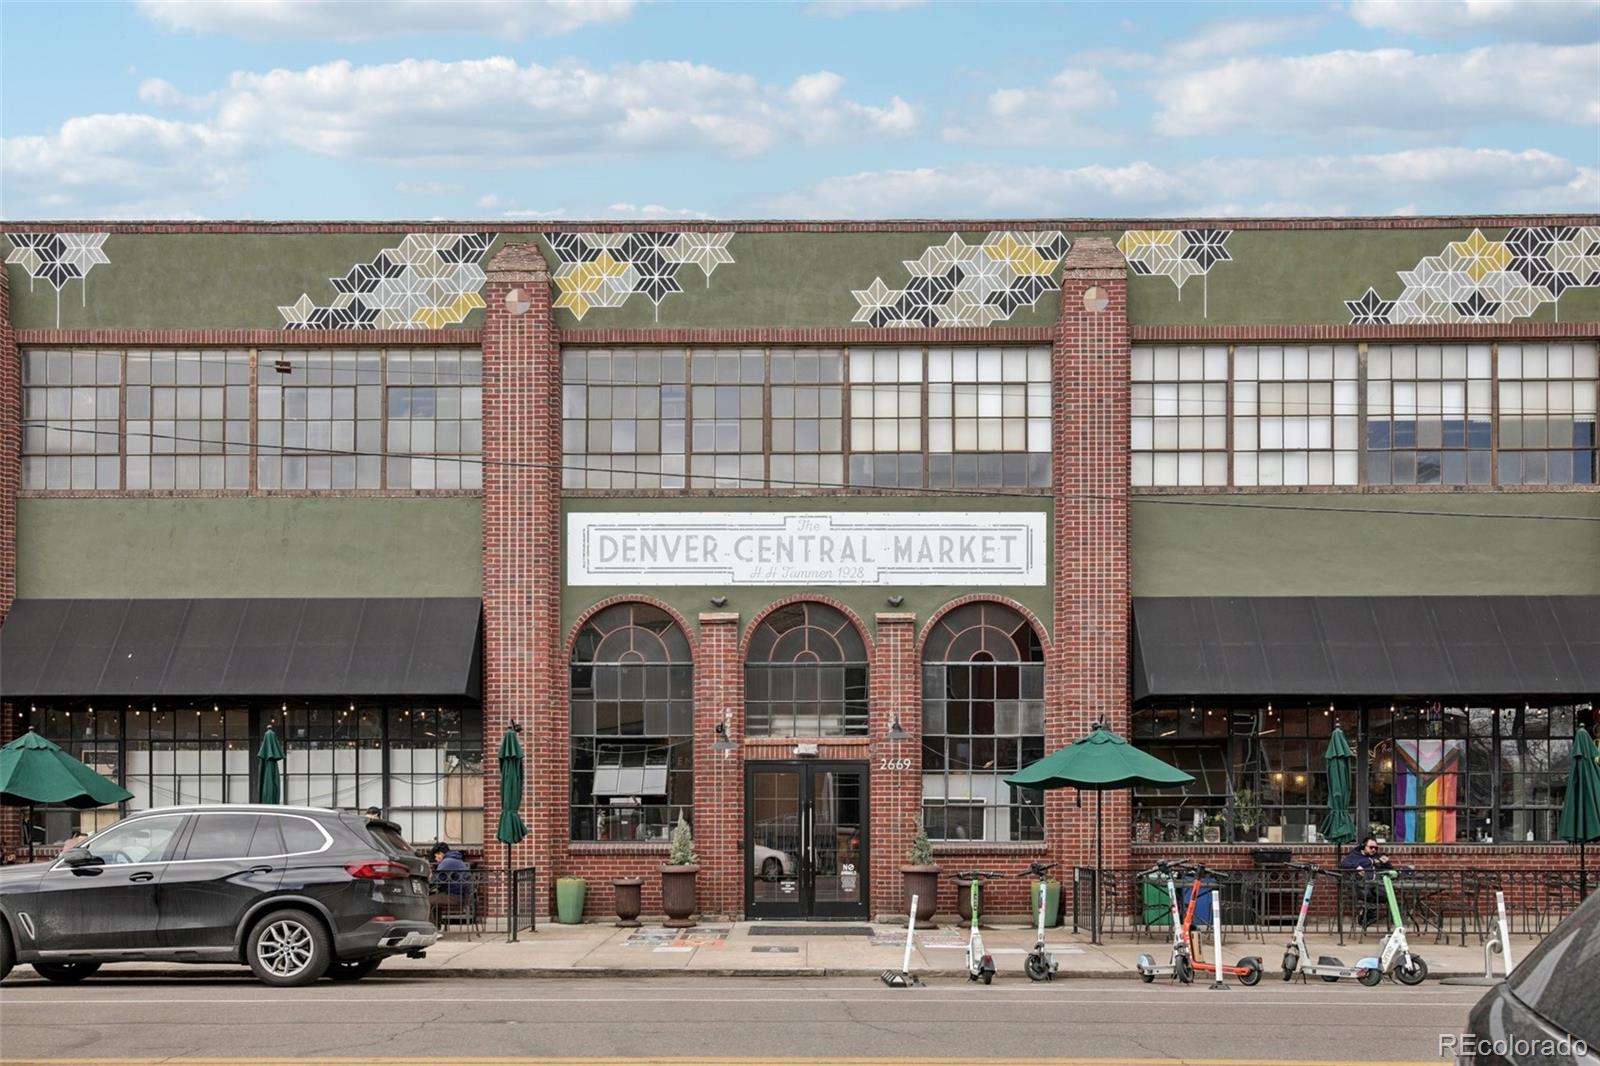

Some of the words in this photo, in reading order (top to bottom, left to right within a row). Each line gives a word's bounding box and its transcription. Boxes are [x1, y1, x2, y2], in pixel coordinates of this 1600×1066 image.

[797, 519, 821, 532] The
[599, 534, 718, 563] DENVER
[734, 535, 876, 563] CENTRAL
[894, 535, 1018, 564] MARKET
[781, 565, 833, 579] Tammen
[837, 566, 865, 579] 1928
[880, 758, 912, 770] 2669
